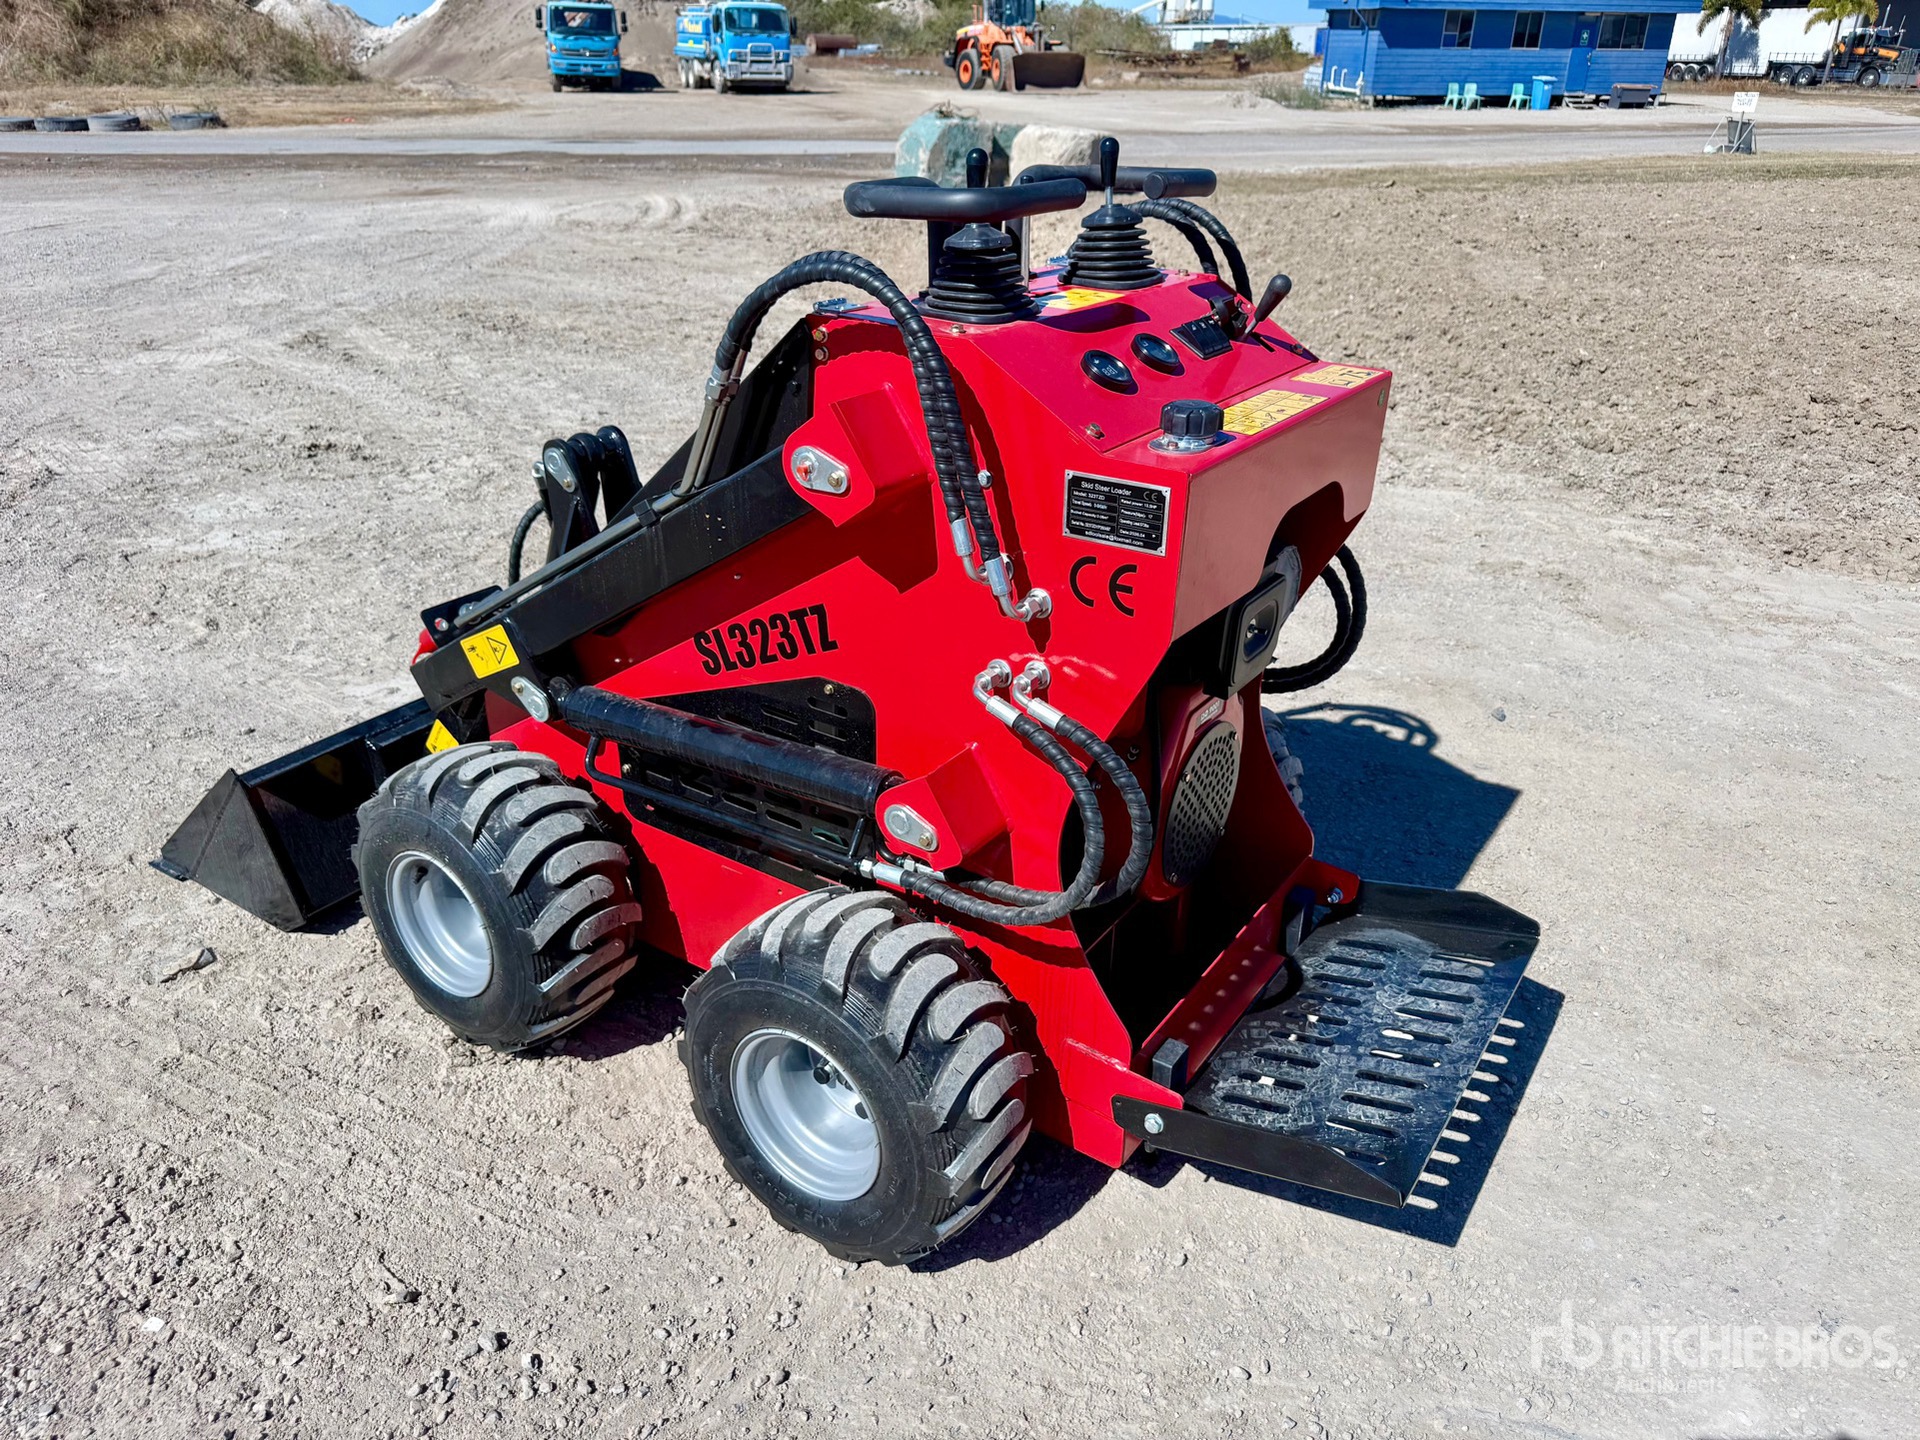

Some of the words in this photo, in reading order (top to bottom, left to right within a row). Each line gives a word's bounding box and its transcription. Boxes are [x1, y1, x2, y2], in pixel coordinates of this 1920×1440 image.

[1080, 480, 1093, 489] Skid
[1094, 483, 1109, 492] Steer
[1110, 486, 1131, 496] Loader
[1143, 490, 1157, 502] CE
[1069, 556, 1138, 617] CE
[693, 603, 839, 675] SL323TZ
